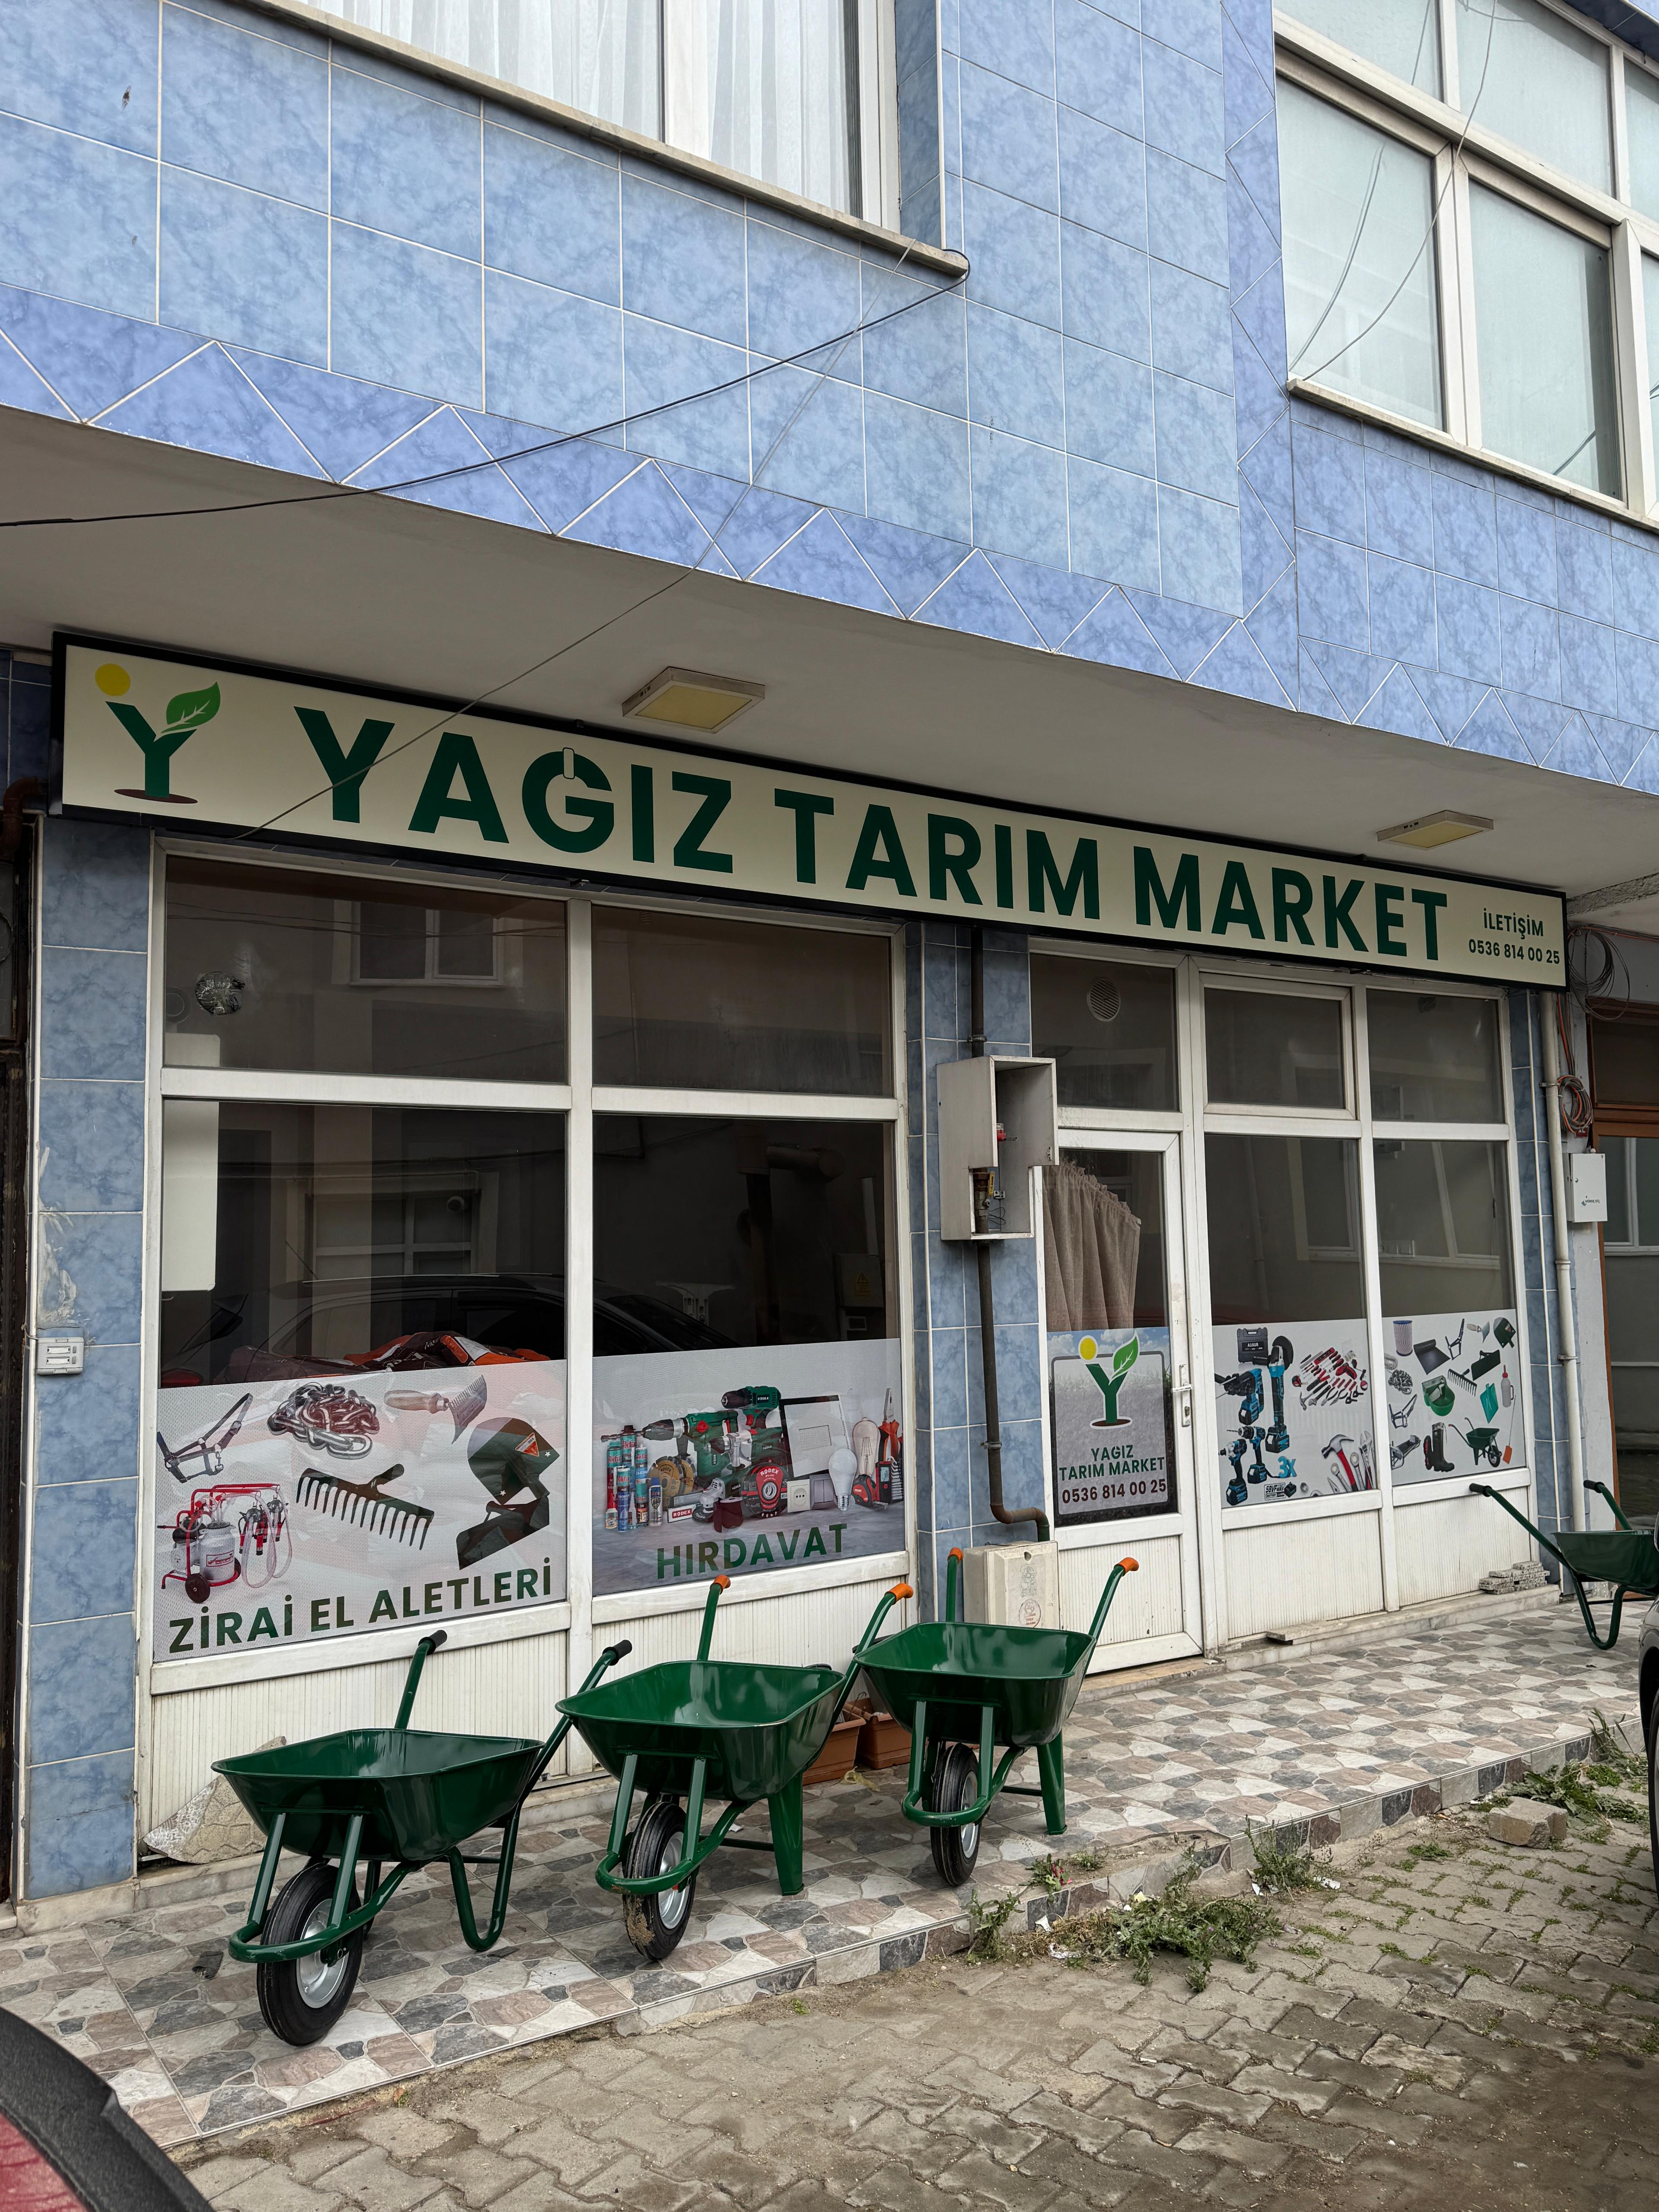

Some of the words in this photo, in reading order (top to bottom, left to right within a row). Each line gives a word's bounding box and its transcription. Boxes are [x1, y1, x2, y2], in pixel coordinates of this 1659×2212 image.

[774, 789, 1100, 920] TARIM
[1133, 846, 1447, 961] MARKET
[1484, 907, 1544, 939] İLETİŞİM
[1468, 939, 1500, 957] 0536
[1504, 944, 1525, 960] 814
[1528, 947, 1543, 962] 00
[1546, 949, 1560, 964] 25
[1059, 1463, 1104, 1481] TARIM
[1109, 1457, 1165, 1476] MARKET
[1062, 1486, 1098, 1503] 0536
[1102, 1483, 1125, 1499] 814
[1129, 1481, 1146, 1496] 00
[1150, 1478, 1166, 1493] 25
[657, 1523, 848, 1580] HIRDAVAT
[168, 1594, 292, 1654] ZİRAİ
[311, 1595, 354, 1632] EL
[368, 1557, 552, 1624] ALETLERİ
